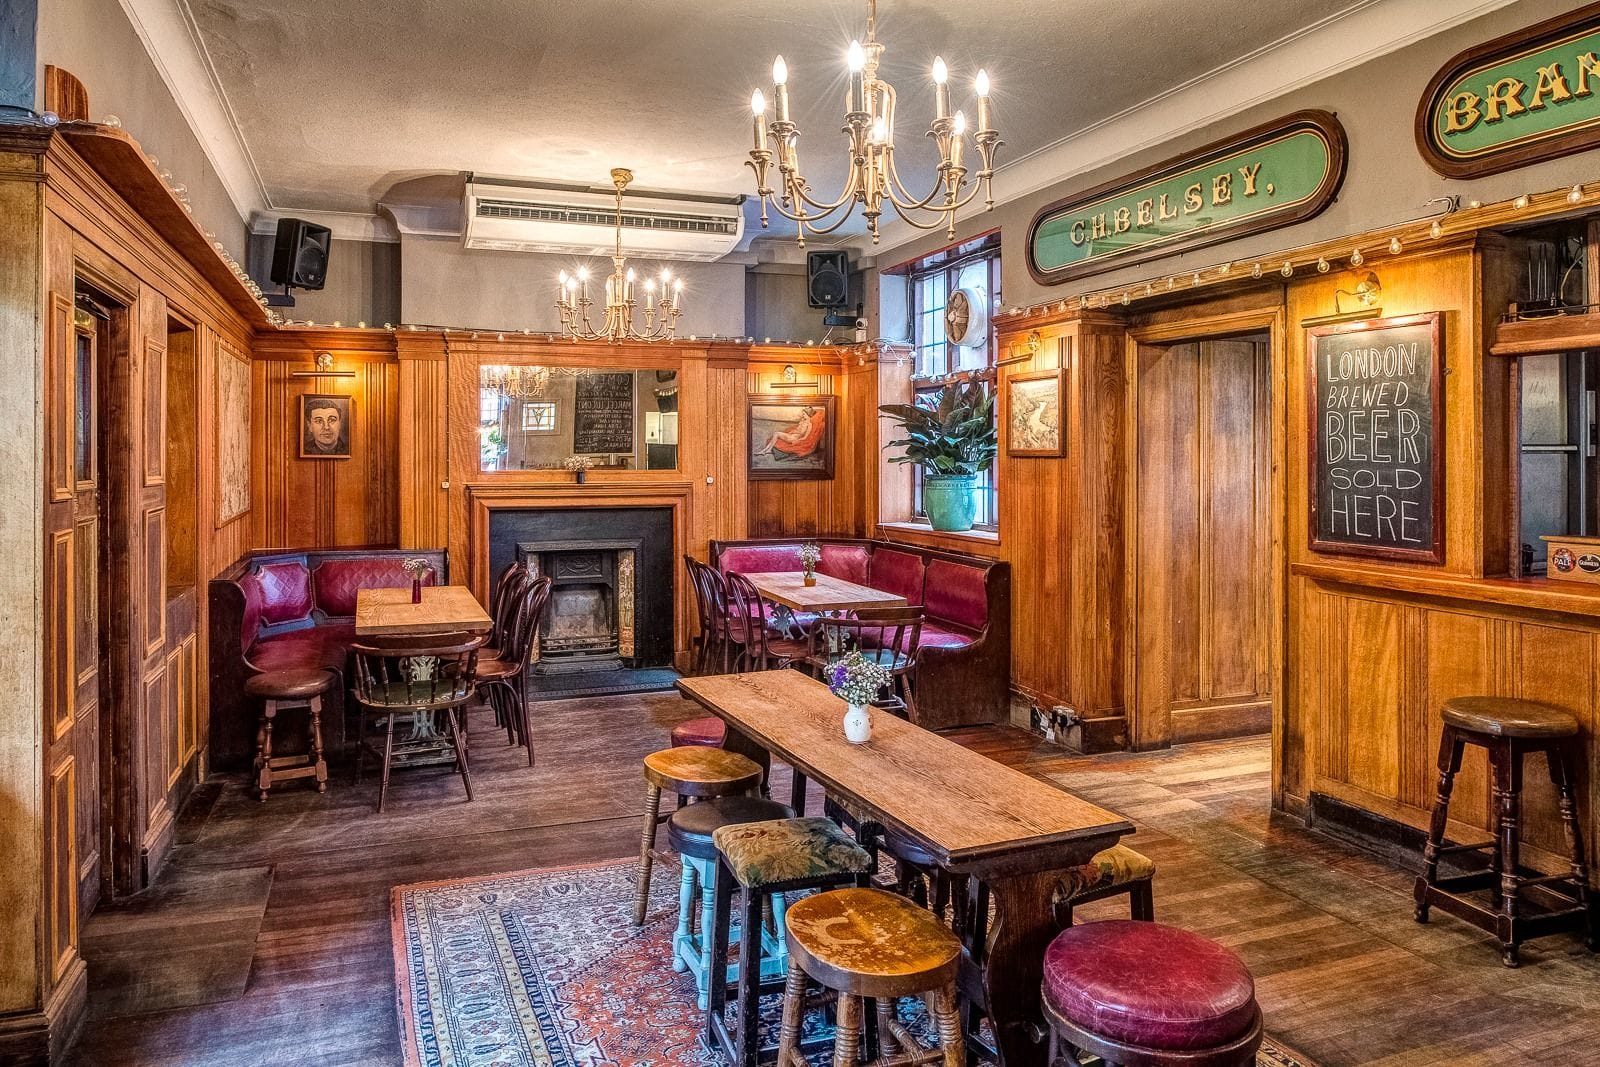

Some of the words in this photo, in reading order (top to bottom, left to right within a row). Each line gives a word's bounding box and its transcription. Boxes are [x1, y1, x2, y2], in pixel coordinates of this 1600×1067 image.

[1327, 342, 1417, 382] LONDON
[1326, 381, 1409, 409] BREWED
[1326, 408, 1421, 465] BEER
[1330, 468, 1422, 490] SOLD
[1331, 489, 1422, 543] HERE
